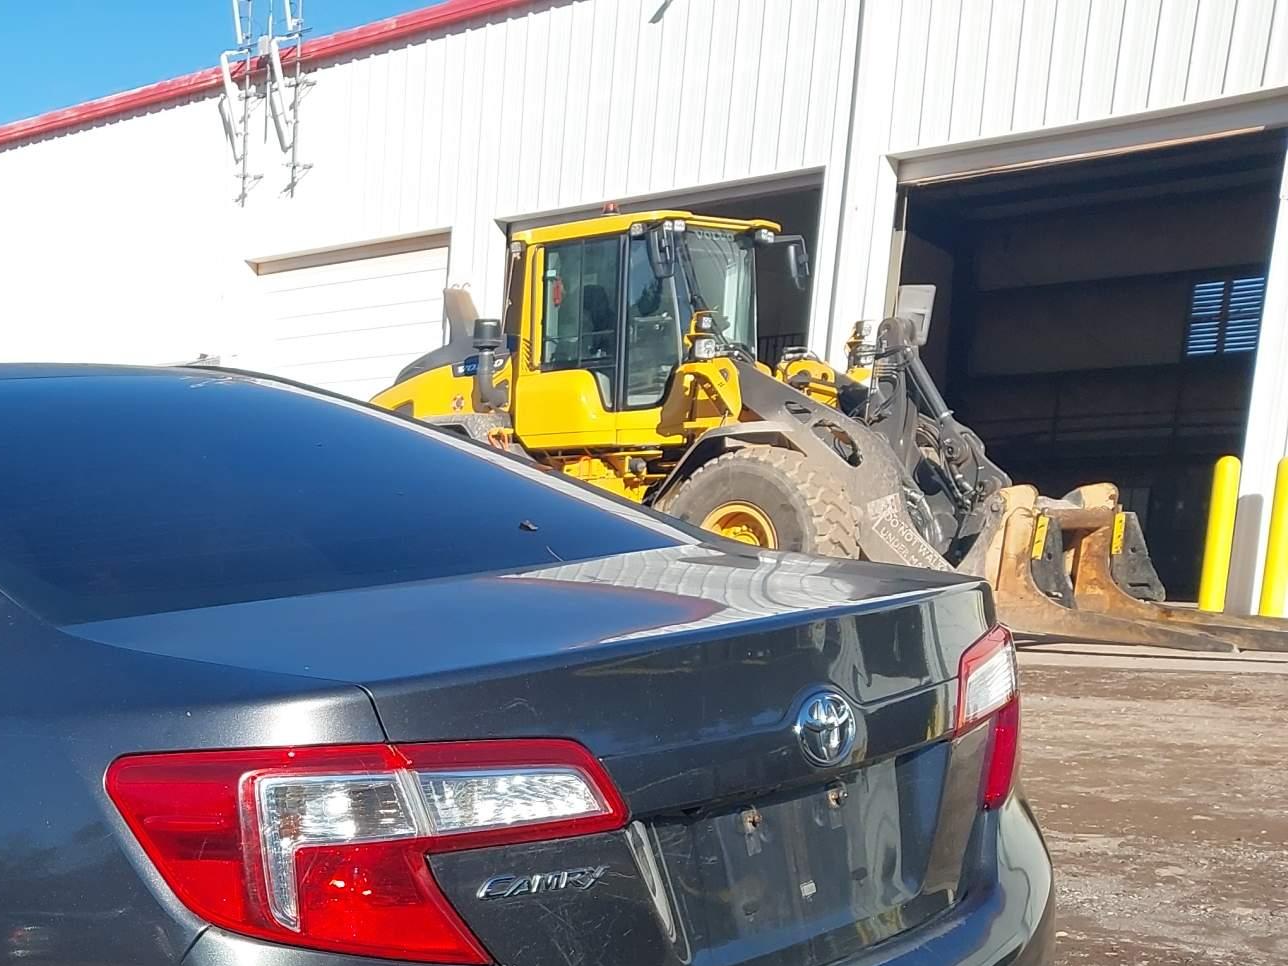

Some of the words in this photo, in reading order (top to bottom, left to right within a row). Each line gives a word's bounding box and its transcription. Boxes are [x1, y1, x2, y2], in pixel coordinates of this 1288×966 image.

[880, 526, 910, 558] UNDER
[883, 510, 900, 528] DO
[898, 521, 919, 546] NOT
[476, 865, 610, 901] CAMRY
